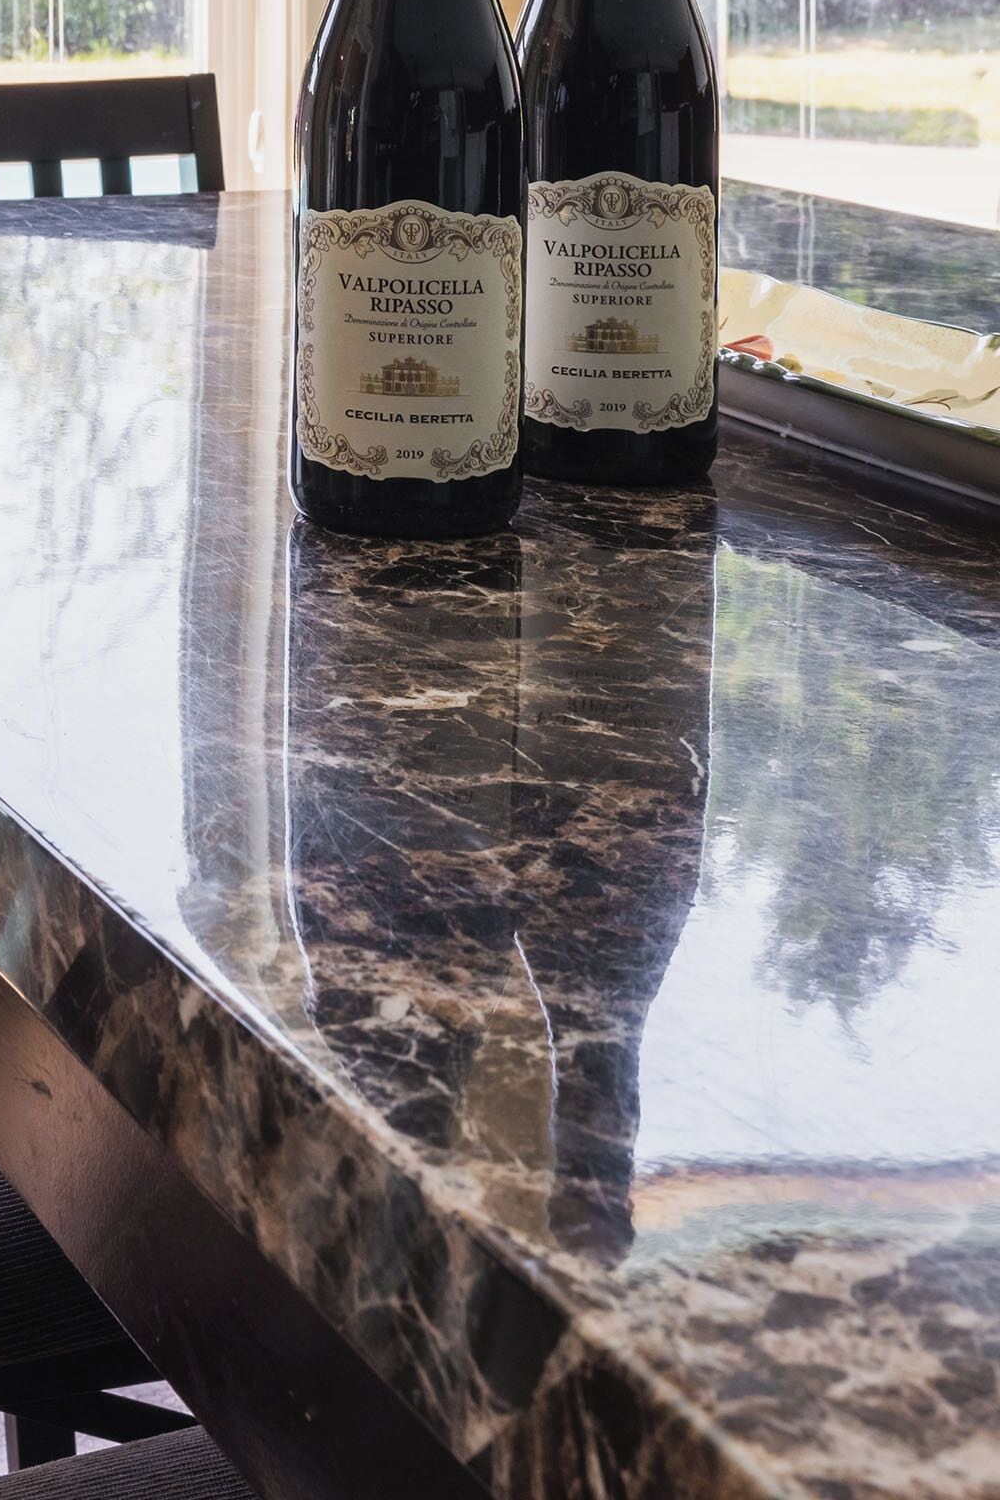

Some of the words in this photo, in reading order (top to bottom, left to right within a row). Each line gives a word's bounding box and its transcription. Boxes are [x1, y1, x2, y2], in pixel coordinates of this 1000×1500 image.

[595, 217, 628, 227] ITALY
[393, 250, 428, 260] ITALY
[543, 239, 681, 260] VALPOLICELLA
[573, 261, 652, 278] RIPASSO
[338, 272, 485, 296] VALPOLICELLA
[549, 277, 601, 290] Denominazione
[602, 280, 610, 290] di
[611, 280, 637, 292] Origine
[369, 296, 454, 315] RIPASSO
[573, 294, 652, 306] SUPERIORE
[344, 313, 399, 328] Denominazione
[400, 318, 408, 328] di
[409, 318, 437, 330] Origine
[368, 331, 453, 345] SUPERIORE
[550, 365, 607, 378] CECILIA
[612, 369, 672, 379] BERETTA
[599, 402, 626, 413] 2019
[344, 408, 404, 423] CECILIA
[409, 413, 474, 424] BERETTA
[395, 449, 424, 460] 2019
